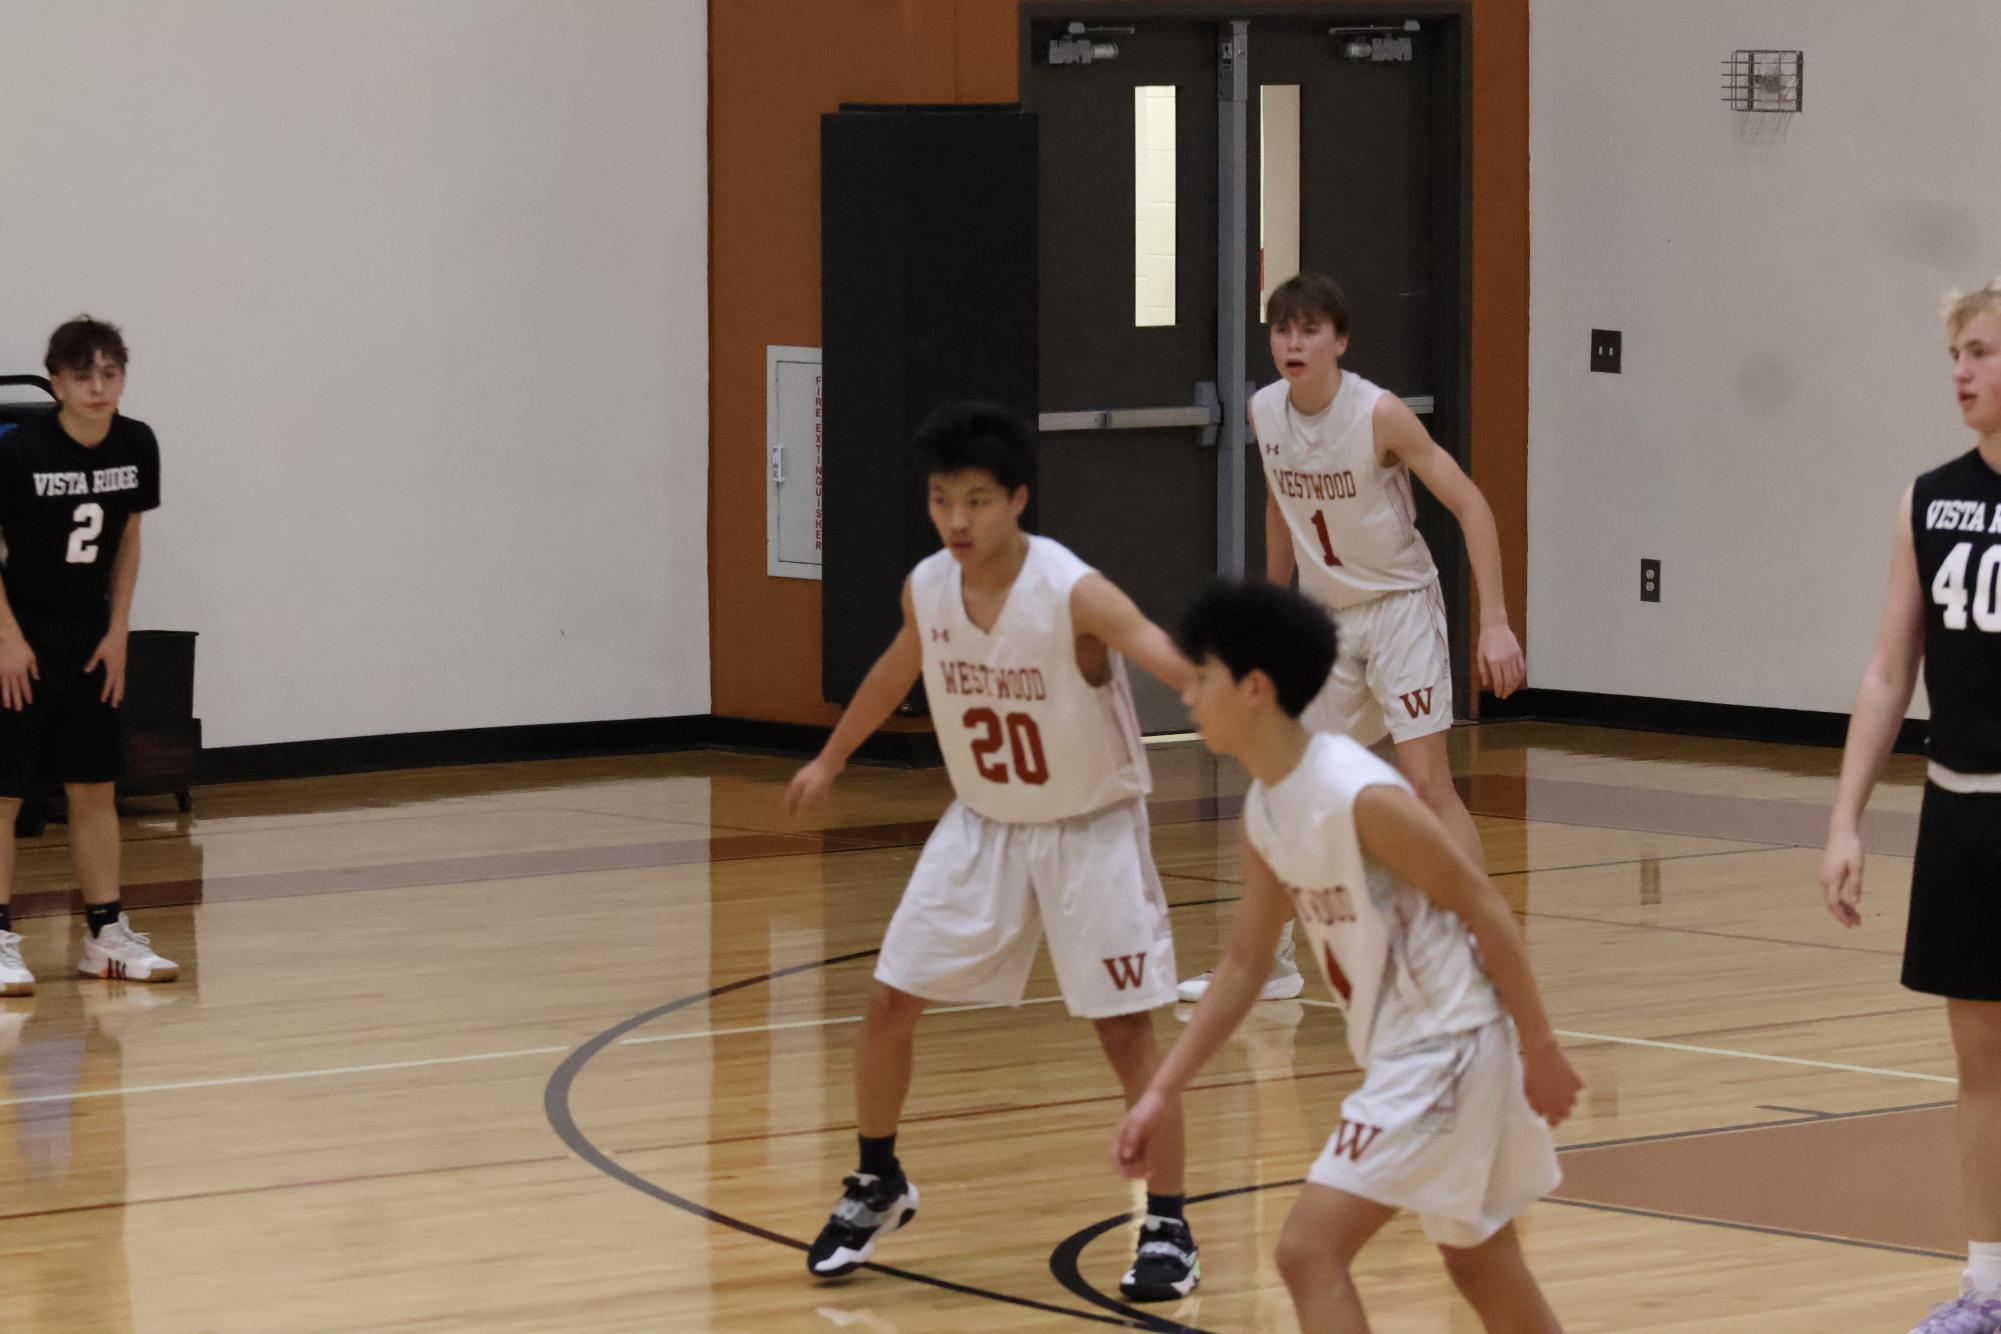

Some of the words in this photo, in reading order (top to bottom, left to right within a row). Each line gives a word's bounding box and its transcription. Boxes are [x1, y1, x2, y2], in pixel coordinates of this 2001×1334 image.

[33, 472, 89, 496] VISTA
[92, 465, 139, 493] RIDGE
[1272, 469, 1357, 500] WESTWOOD
[65, 502, 104, 564] 2
[1926, 499, 1986, 532] VISTA
[1310, 509, 1344, 567] 1
[1931, 541, 2001, 633] 40
[939, 660, 1047, 701] WESTWOOD
[1399, 686, 1433, 719] W
[962, 706, 1048, 786] 20
[1102, 952, 1147, 991] W
[1334, 1119, 1383, 1161] W
